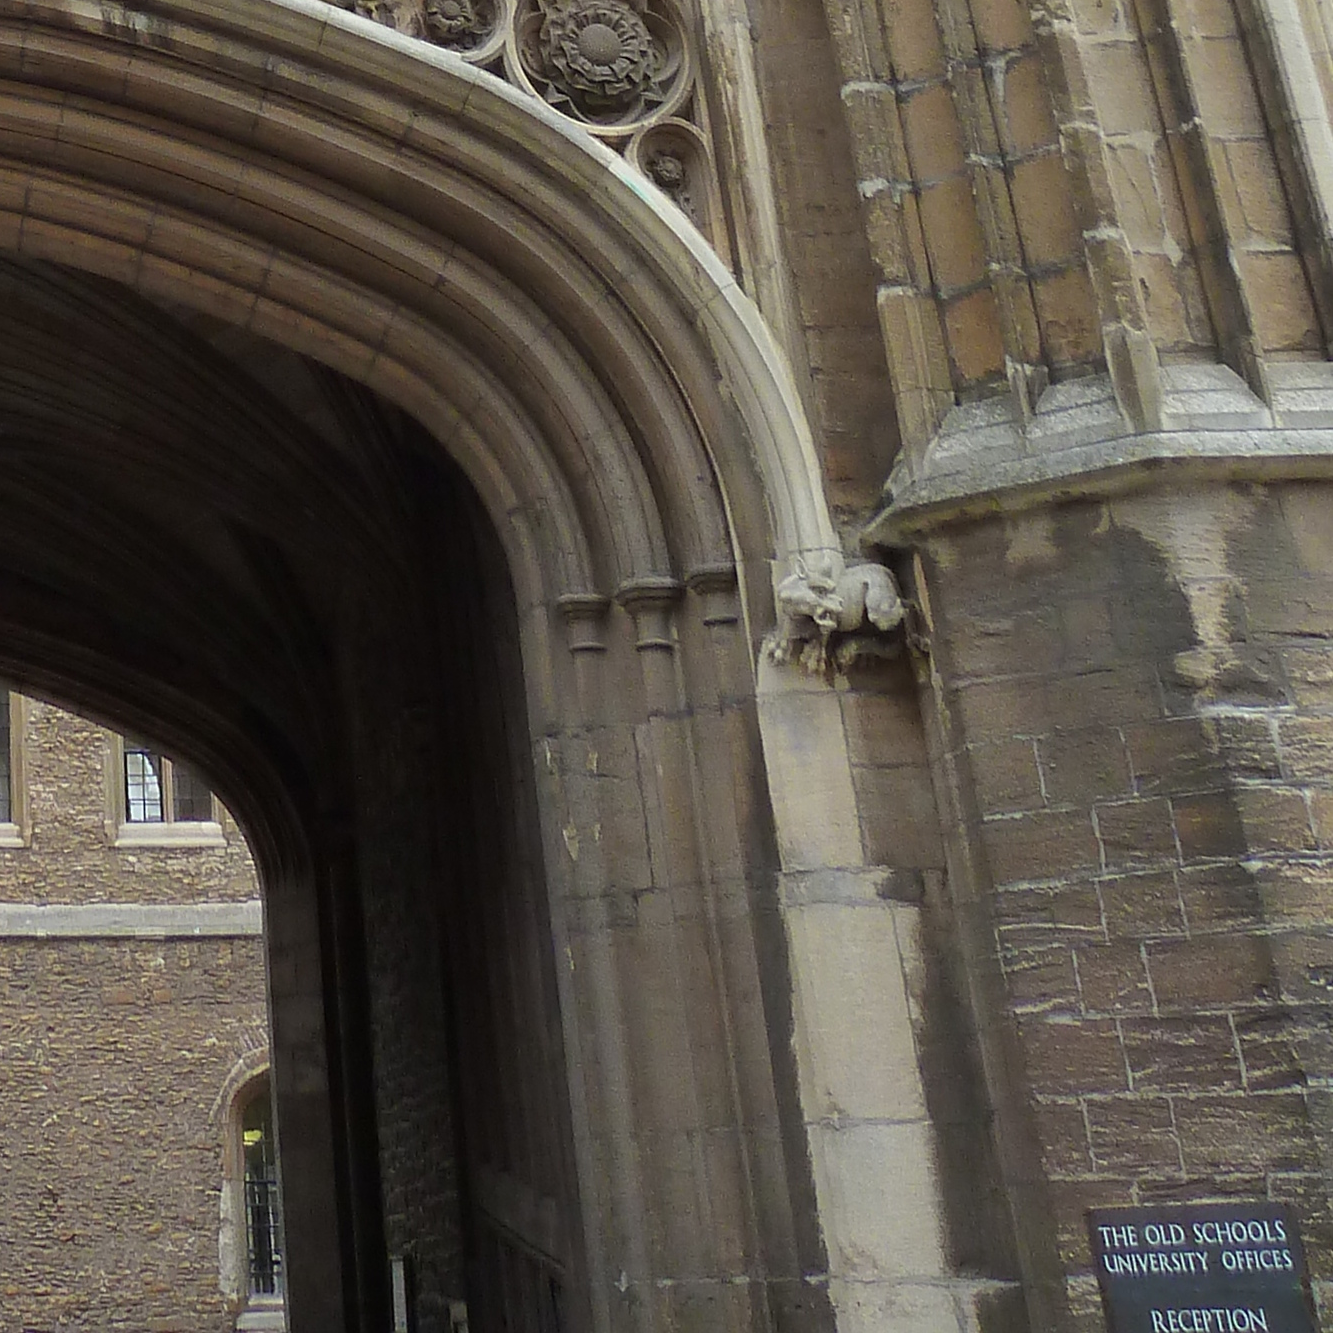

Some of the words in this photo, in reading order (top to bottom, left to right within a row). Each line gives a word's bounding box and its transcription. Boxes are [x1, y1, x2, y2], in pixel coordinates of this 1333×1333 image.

[1098, 1225, 1138, 1248] THE
[1145, 1224, 1185, 1245] OLD
[1192, 1220, 1286, 1244] SCHOOLS
[1103, 1253, 1208, 1273] UNIVERSITY
[1222, 1250, 1293, 1270] OFFICES
[1150, 1308, 1269, 1333] RECEPTION
